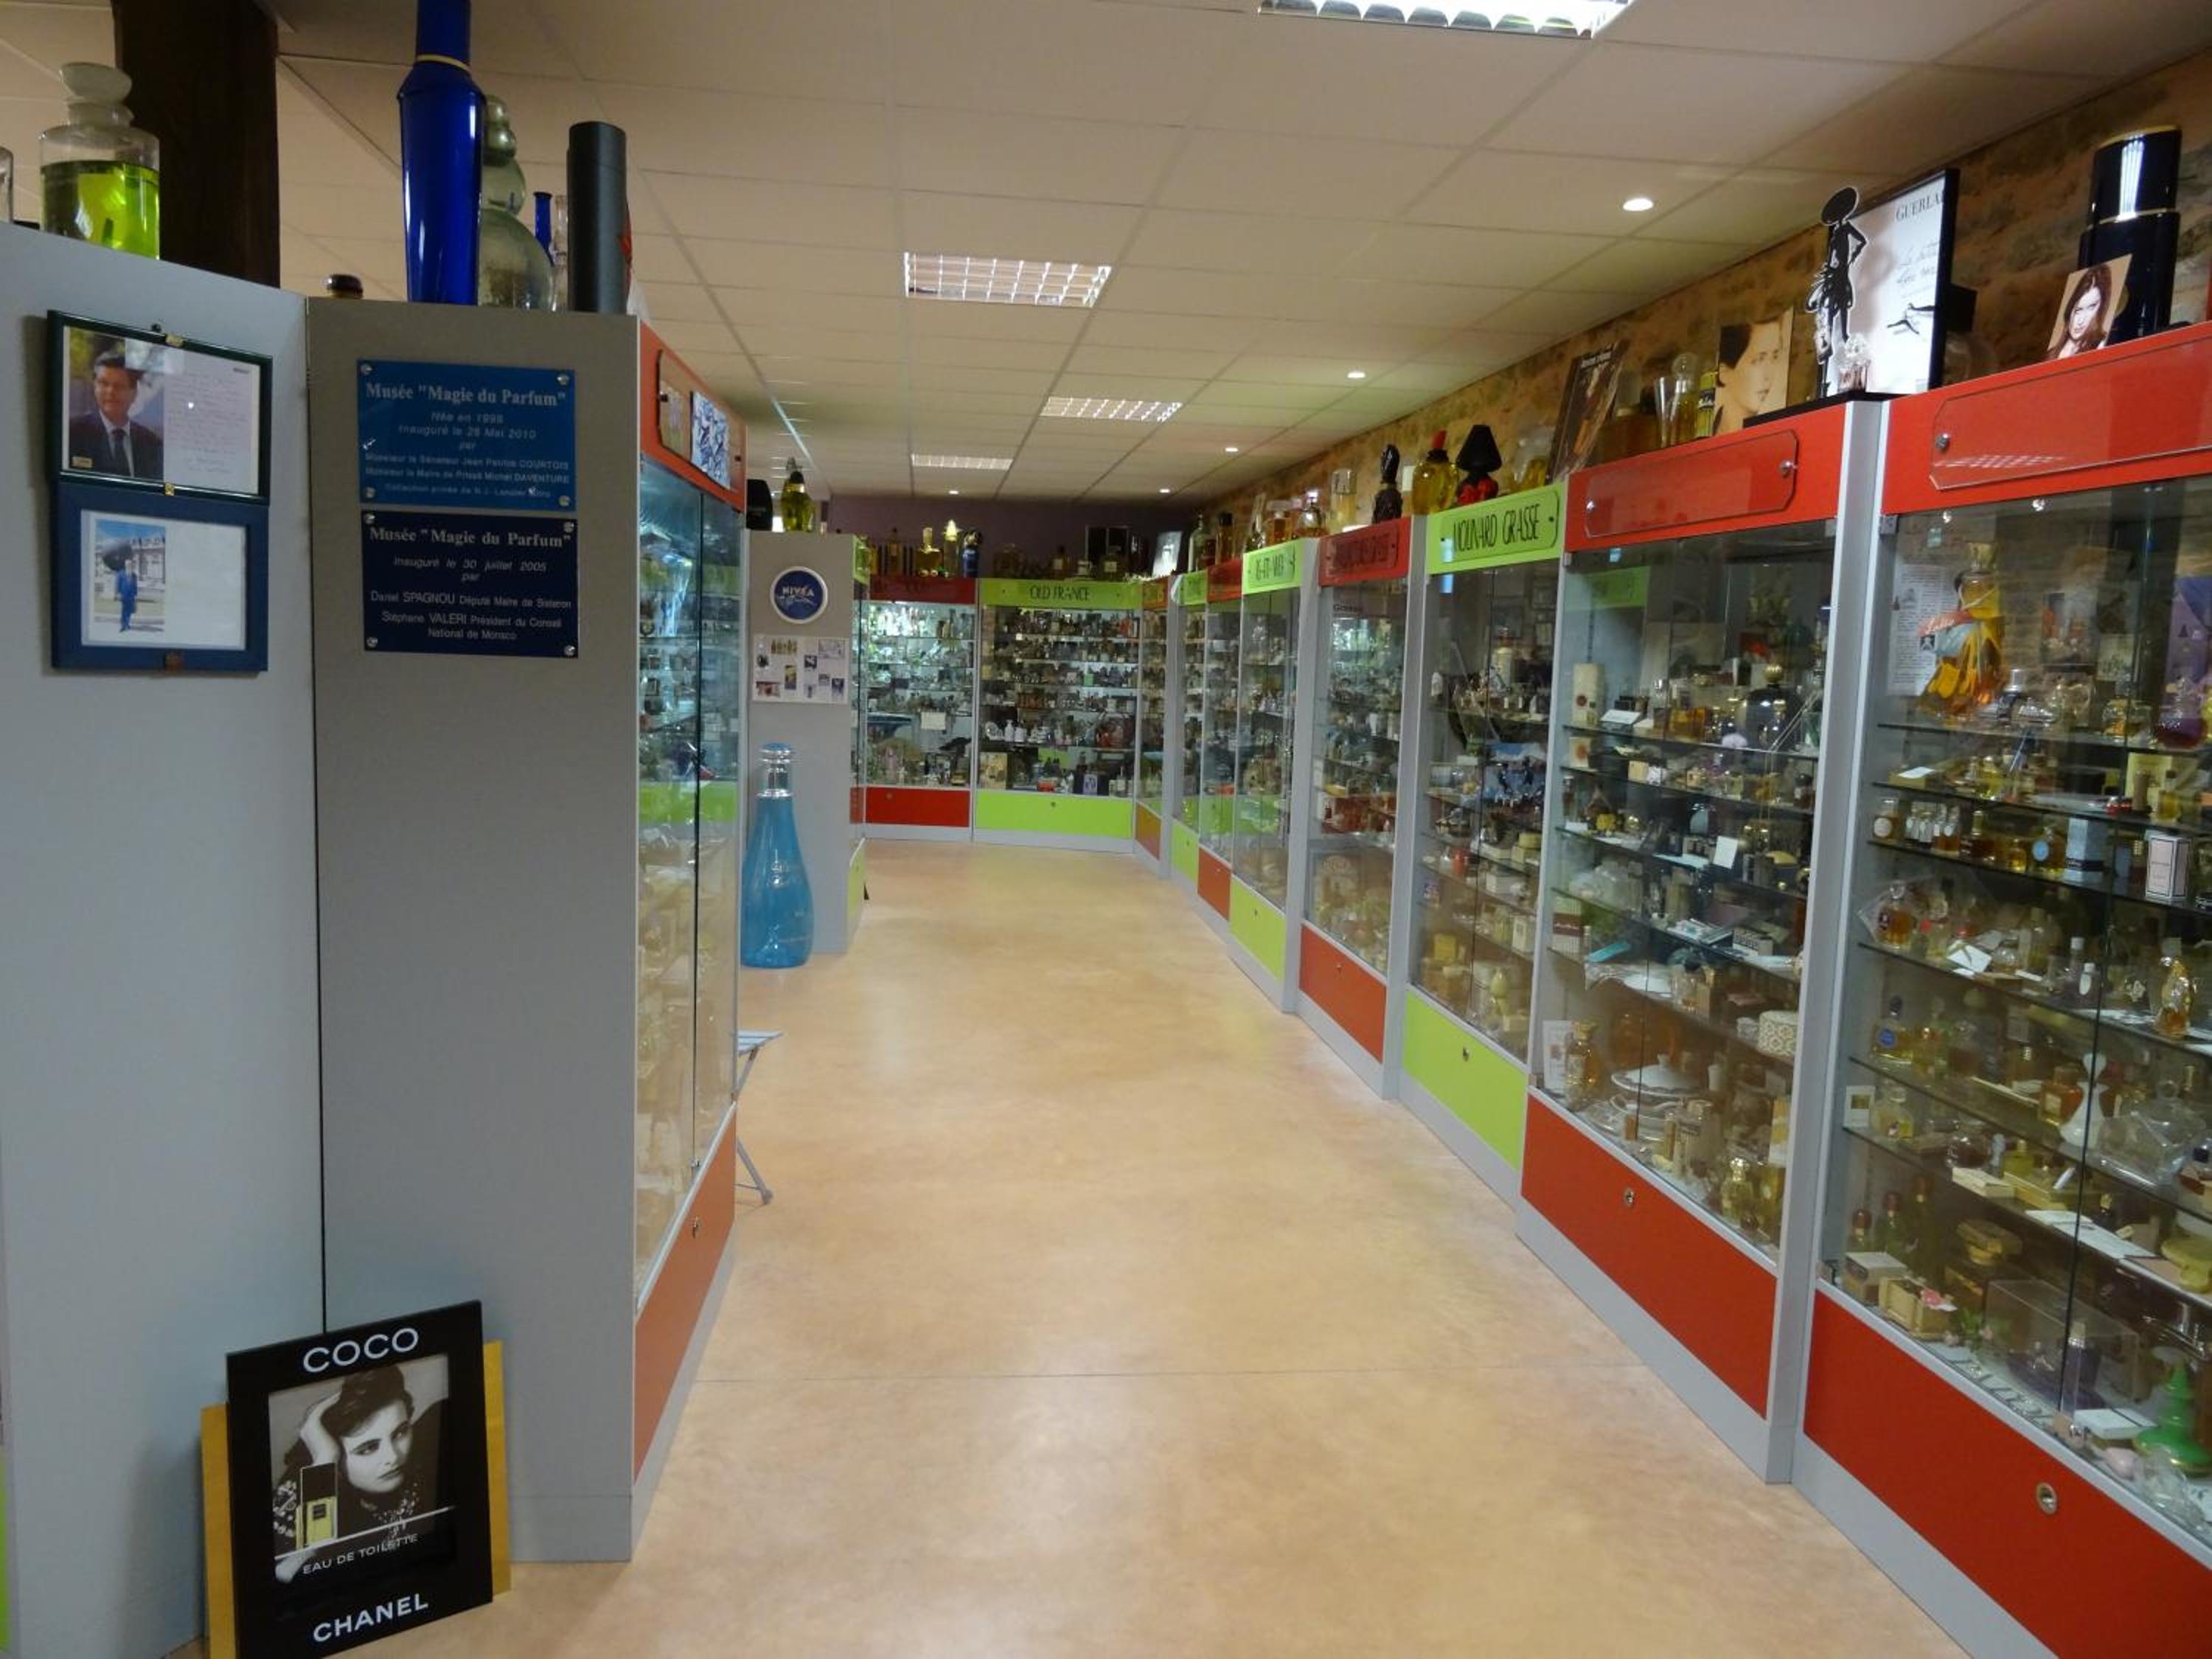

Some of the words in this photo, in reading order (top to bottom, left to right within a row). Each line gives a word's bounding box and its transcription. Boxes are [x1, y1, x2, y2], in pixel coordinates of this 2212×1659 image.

[366, 382, 413, 399] Musée
[478, 388, 496, 403] du
[484, 428, 504, 437] Mai
[508, 428, 537, 439] 2010
[519, 459, 569, 470] COURTOIS
[514, 472, 570, 484] DAVENTURE
[1502, 504, 1540, 545] GRASSE
[369, 526, 417, 542] Musée
[481, 532, 501, 546] du
[394, 556, 441, 570] Inauguré
[446, 558, 457, 568] le
[484, 560, 514, 571] juillet
[461, 572, 480, 582] par
[370, 590, 399, 602] Daniel
[403, 591, 456, 605] SPAGNOU
[494, 597, 518, 608] Maire
[522, 598, 533, 608] de
[1054, 585, 1091, 601] FRANCE
[428, 612, 467, 625] VALERI
[470, 615, 512, 627] Président
[515, 617, 527, 627] du
[428, 627, 465, 639] National
[467, 629, 479, 639] de
[303, 1327, 420, 1373] COCO
[303, 1559, 332, 1575] EAU
[336, 1551, 355, 1565] DE
[359, 1534, 419, 1558] TOILETTE
[313, 1593, 429, 1643] CHANEL
